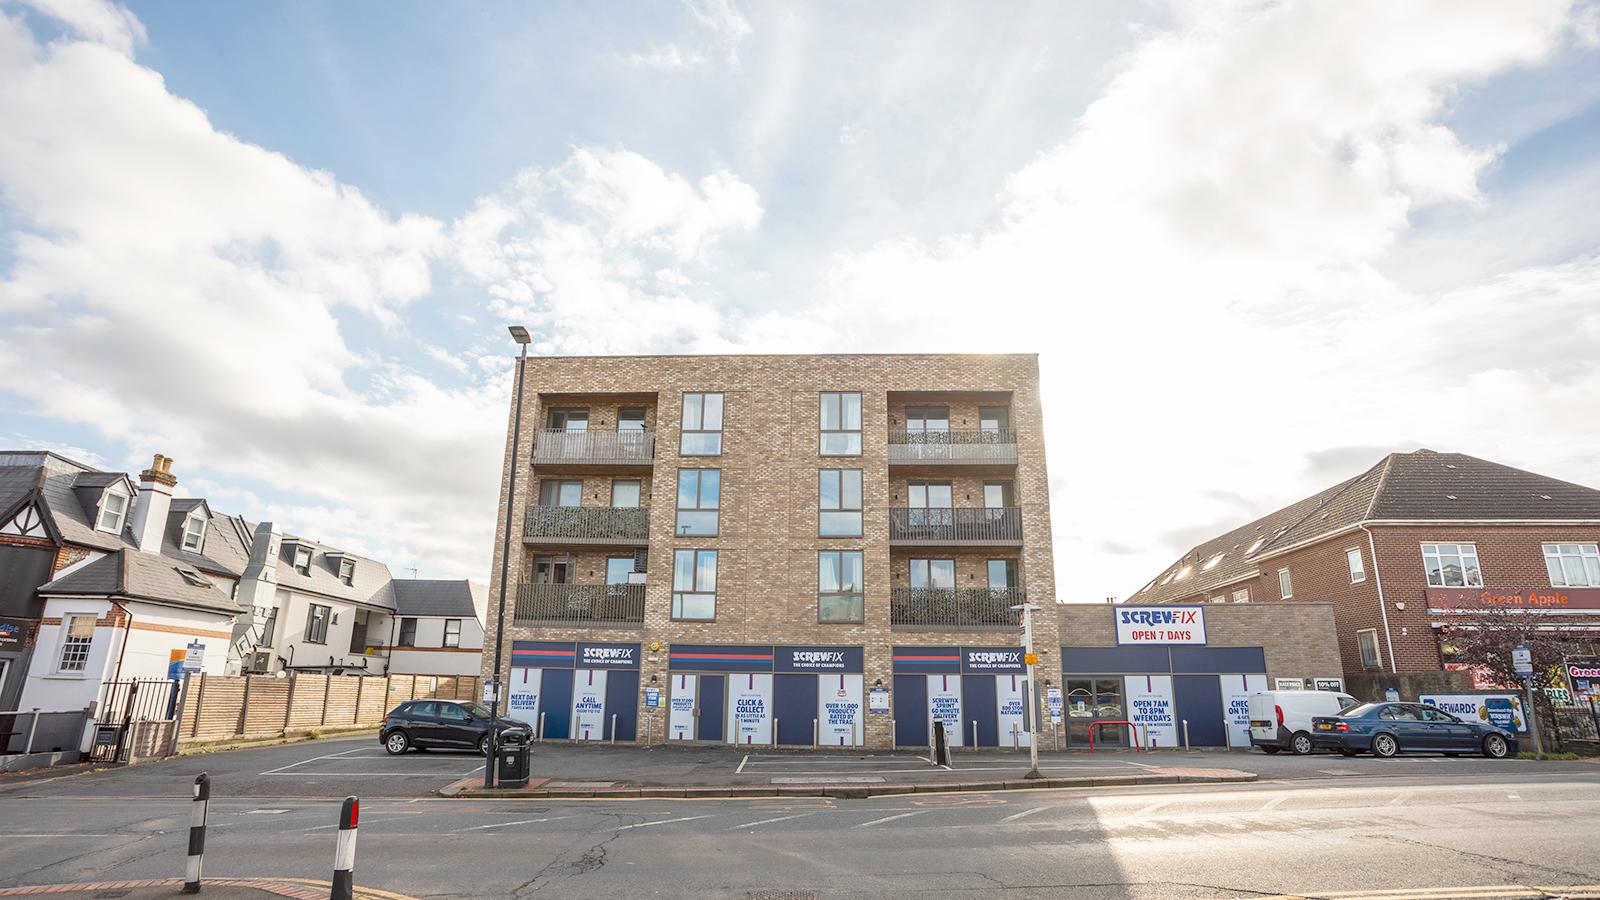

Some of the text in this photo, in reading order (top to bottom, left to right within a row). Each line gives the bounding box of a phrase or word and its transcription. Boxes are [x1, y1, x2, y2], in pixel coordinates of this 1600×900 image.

[1480, 591, 1568, 606] Green Apple
[1121, 611, 1197, 627] SCREWFIX
[1132, 631, 1191, 640] OPEN 7 DAYS
[583, 647, 633, 660] SCREWFIX
[793, 651, 844, 663] SCREWFIX
[968, 652, 1020, 664] SCREWFIX
[1439, 703, 1476, 714] REWARDS
